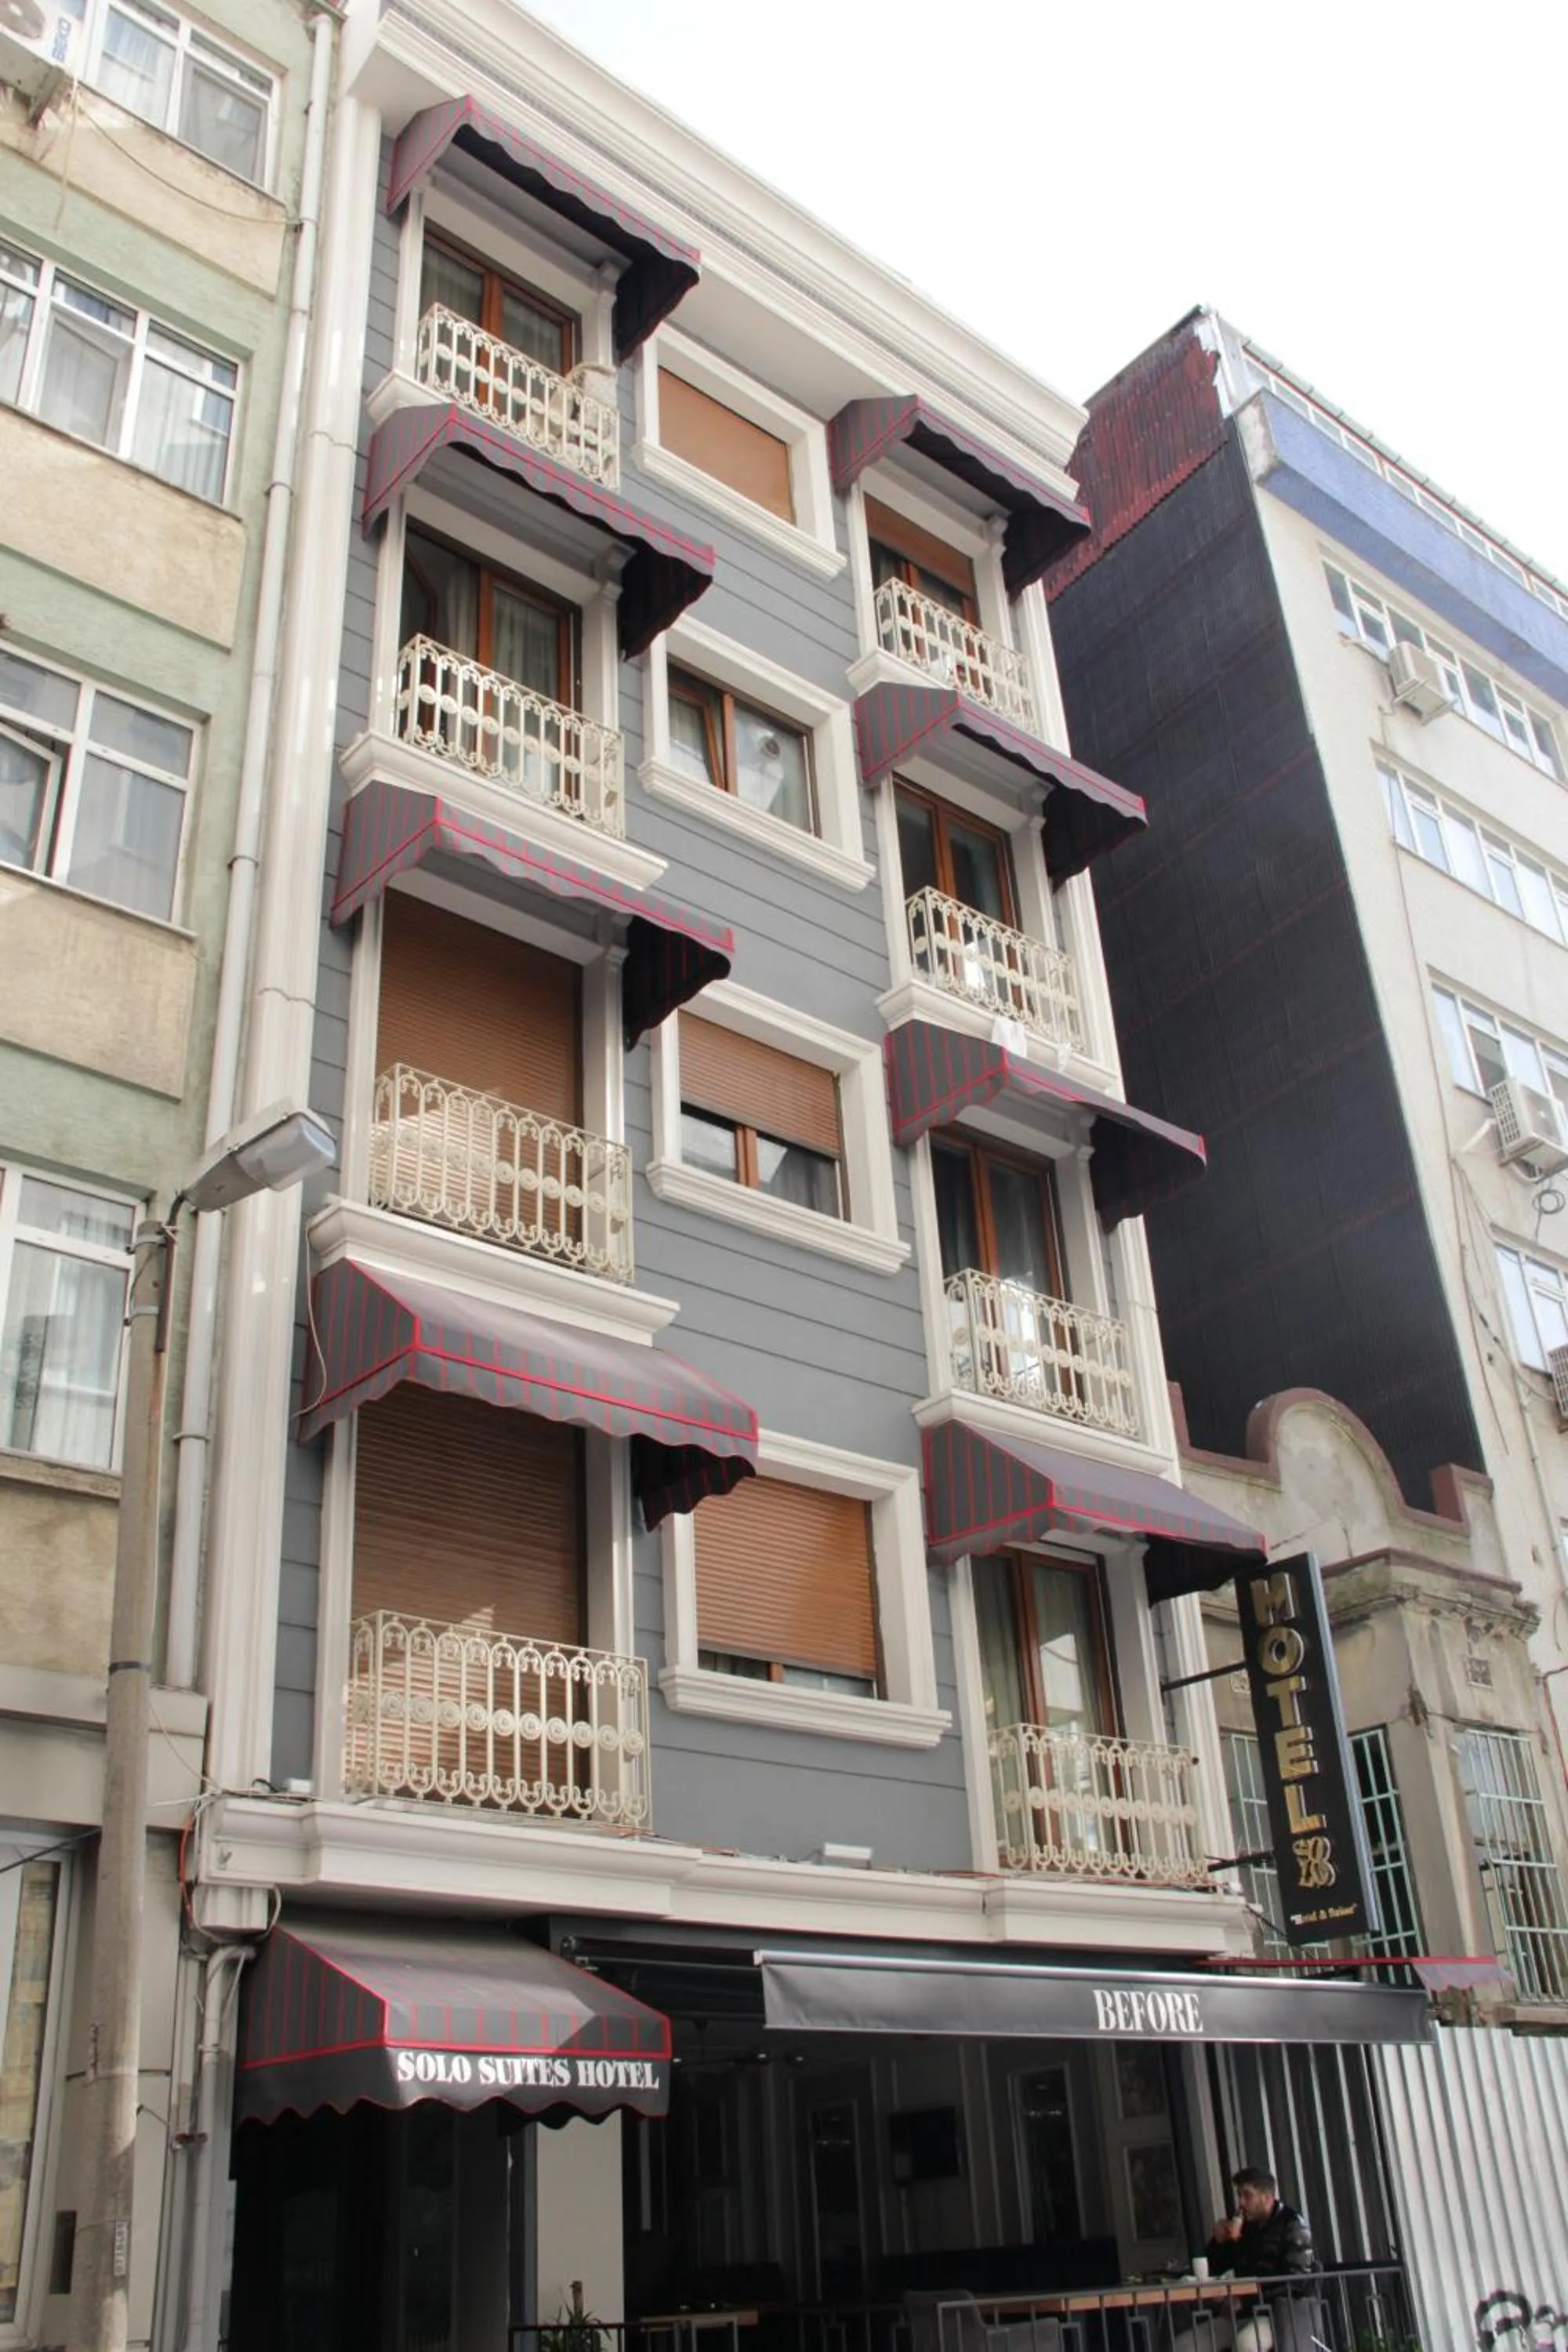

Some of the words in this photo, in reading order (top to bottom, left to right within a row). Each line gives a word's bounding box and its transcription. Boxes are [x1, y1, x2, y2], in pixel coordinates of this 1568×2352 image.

[1250, 1571, 1327, 1834] HOTEL
[1092, 1989, 1203, 2033] BEFORE
[397, 2051, 472, 2084] SOLO
[477, 2056, 570, 2089] SUITES
[575, 2059, 659, 2089] HOTEL
